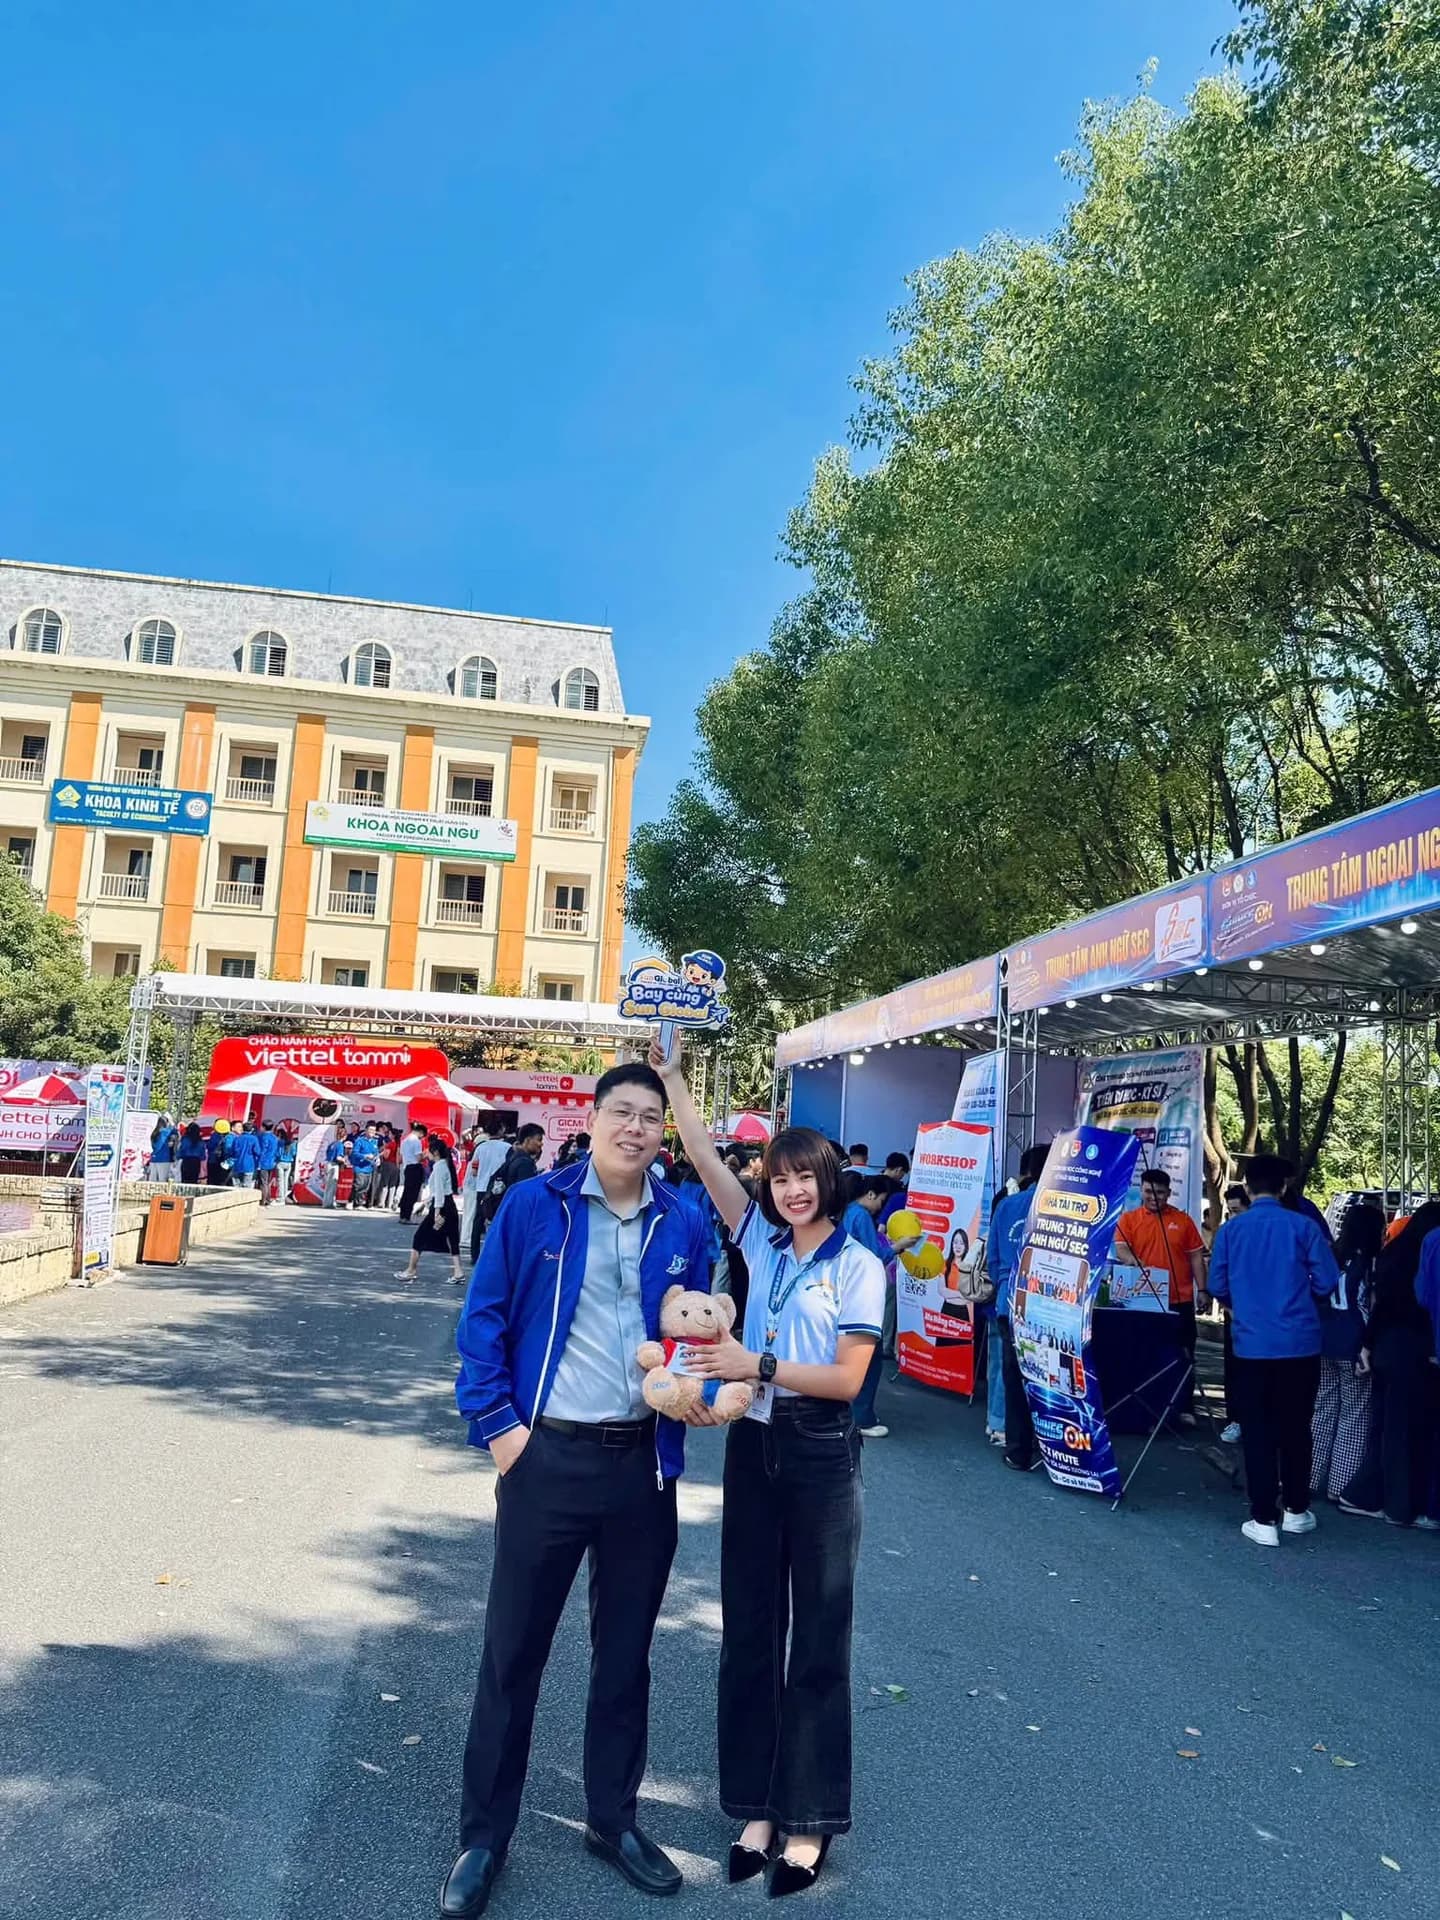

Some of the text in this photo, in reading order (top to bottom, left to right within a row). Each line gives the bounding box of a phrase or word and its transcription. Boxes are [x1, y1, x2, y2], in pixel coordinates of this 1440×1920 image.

[85, 793, 121, 809] KHOA
[126, 796, 159, 814] KINH
[347, 816, 391, 832] KHOA
[1286, 866, 1329, 913] TRUNG
[1332, 852, 1362, 899] TÂM
[1366, 836, 1414, 889] NGOẠI
[1045, 954, 1070, 983] TRUNG
[1131, 928, 1149, 958] SEC
[631, 986, 700, 1006] Bay cùng
[622, 1000, 710, 1019] Sun Global
[244, 1048, 339, 1066] viettel
[16, 1130, 41, 1140] CHO
[919, 1153, 977, 1169] WORKSHOP
[1071, 1198, 1090, 1215] TRỢ
[1036, 1218, 1065, 1234] TRUNG
[1066, 1220, 1088, 1239] TÂM
[1029, 1232, 1089, 1256] ANH NGỮ SEC
[1064, 1425, 1091, 1451] ON
[1052, 1450, 1080, 1466] HYUTE
